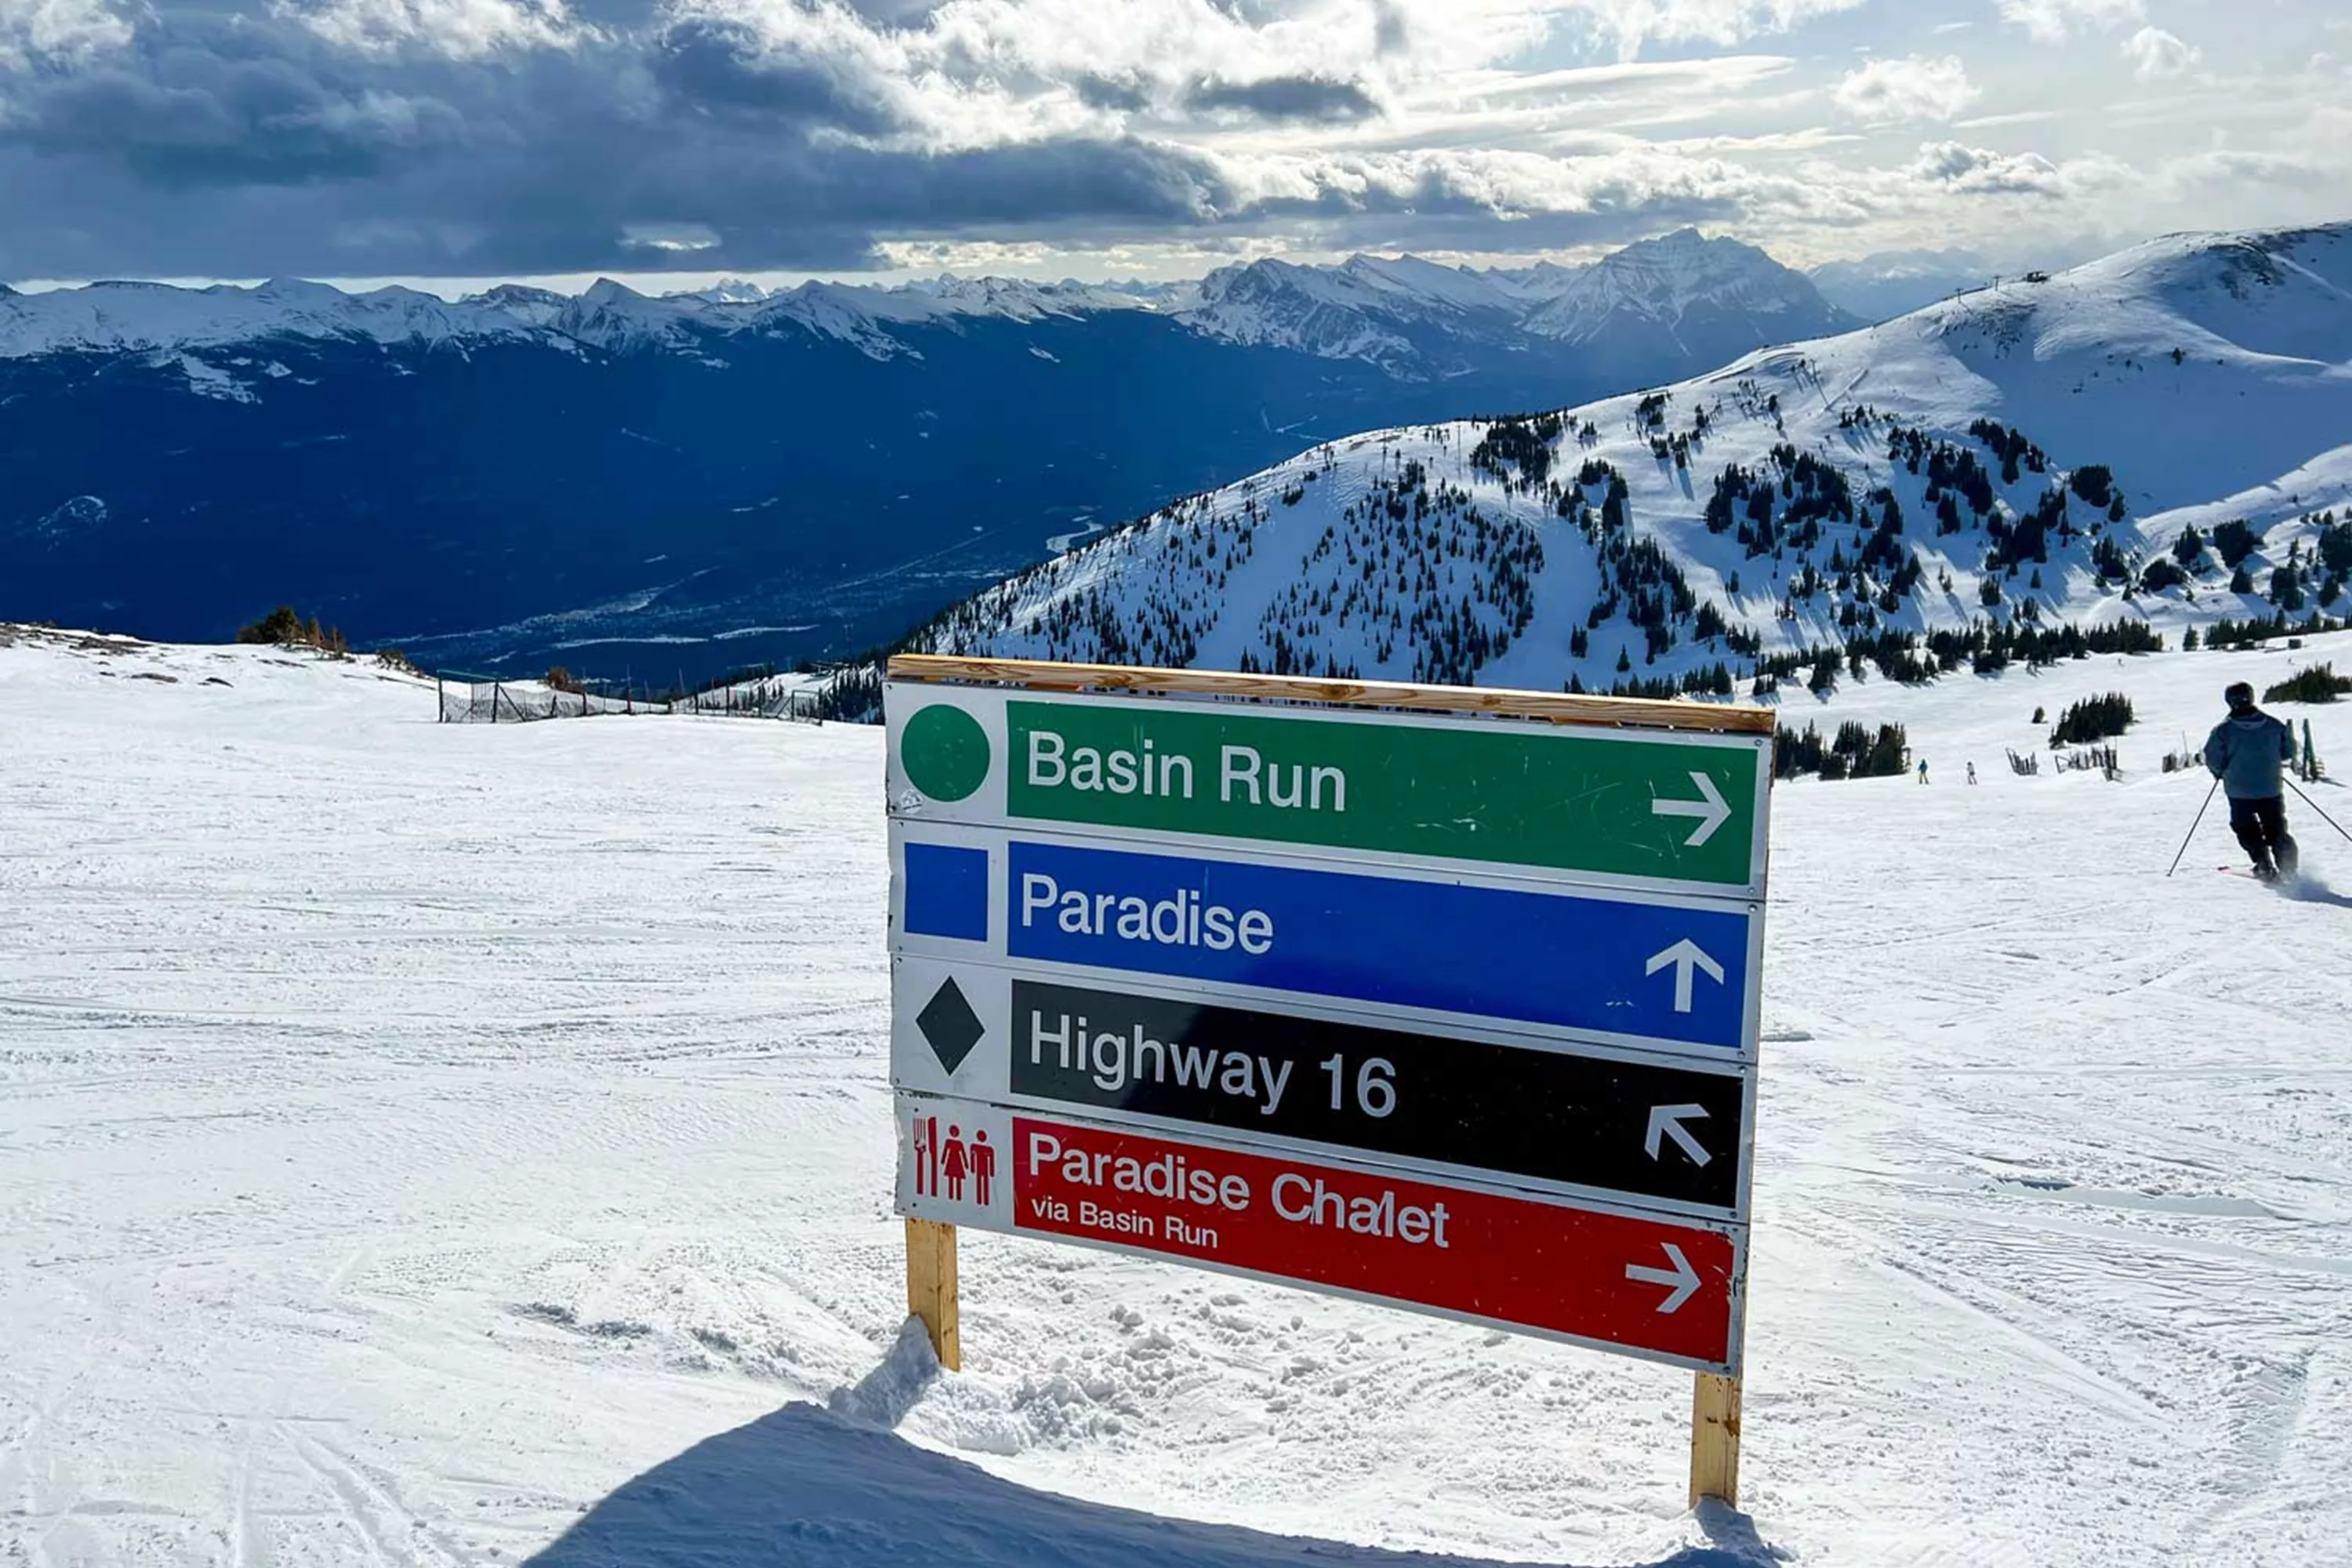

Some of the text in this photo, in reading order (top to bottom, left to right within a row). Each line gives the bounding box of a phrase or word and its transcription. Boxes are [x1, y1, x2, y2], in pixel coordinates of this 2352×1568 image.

[1028, 731, 1346, 811] Basin Run
[1022, 873, 1274, 955] Paradise
[1031, 1011, 1397, 1118] Highway 16
[1029, 1132, 1450, 1248] Paradise Chalet
[1032, 1196, 1218, 1248] via Basin Run
